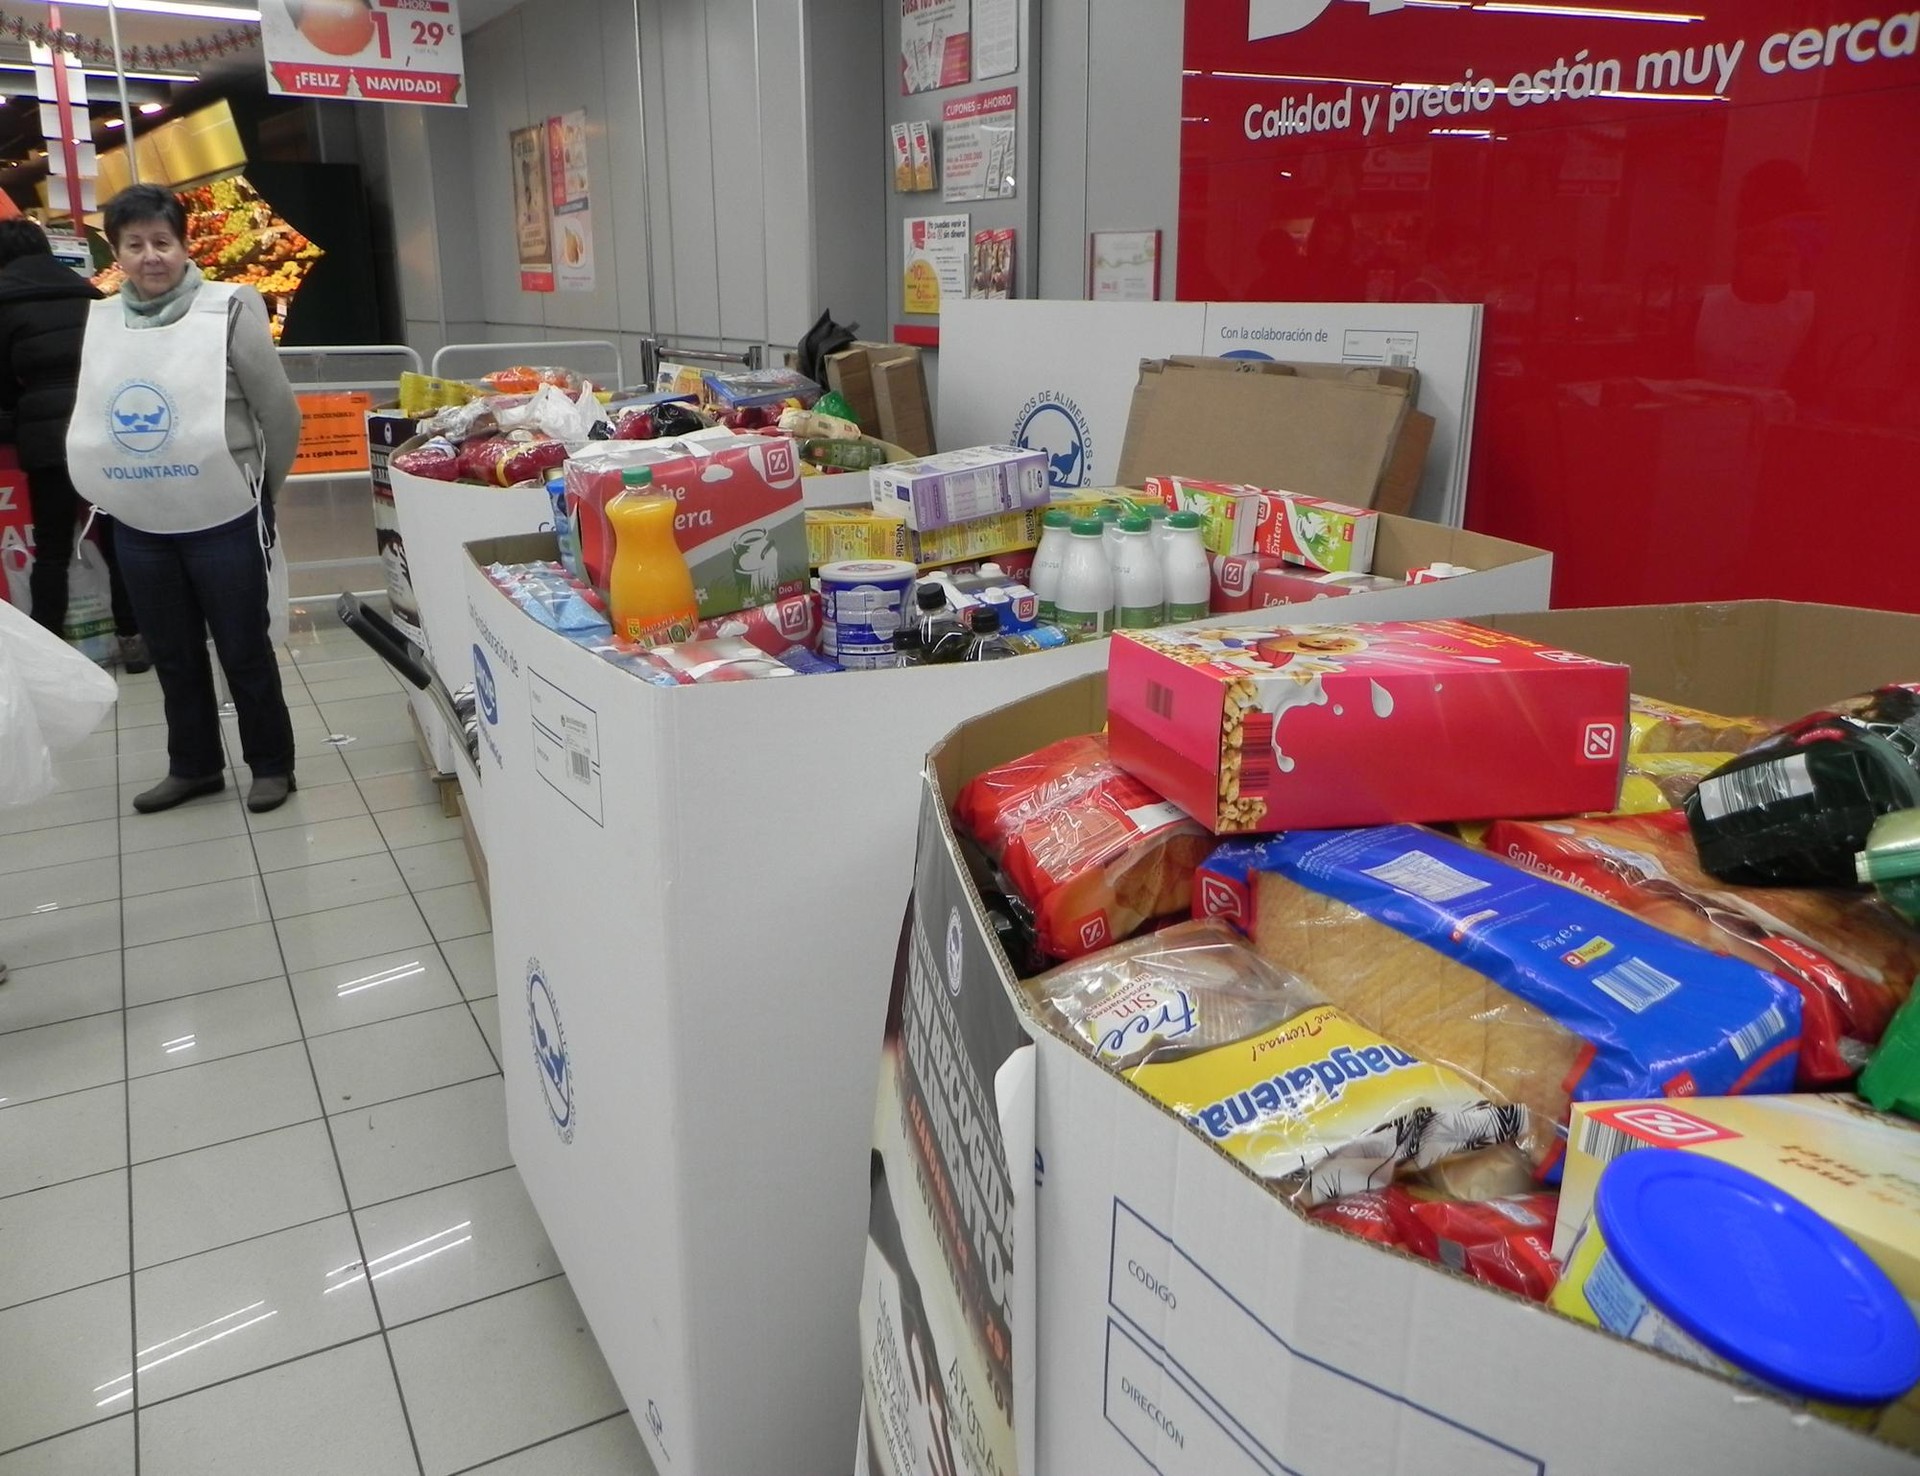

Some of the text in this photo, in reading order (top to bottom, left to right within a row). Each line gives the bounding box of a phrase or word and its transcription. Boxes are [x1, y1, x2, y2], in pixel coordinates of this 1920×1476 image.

[295, 72, 442, 94] ¡FELIZ NAVIDAD!
[1244, 11, 1920, 140] Calidad y precio están muy cerca
[946, 101, 976, 117] CUPONES
[983, 94, 1012, 110] AHORRO
[1220, 326, 1329, 342] Con la colaboración de
[1038, 390, 1052, 404] DE
[1054, 391, 1094, 460] ALIMENTOS
[102, 463, 200, 480] VOLUNTARIO
[895, 522, 905, 557] Nestlé
[1270, 511, 1284, 556] Entera
[1263, 592, 1293, 608] Lech
[1507, 842, 1566, 880] Galleta
[1095, 989, 1198, 1058] Free
[1112, 992, 1158, 1020] Sin
[1251, 1021, 1323, 1062] Tiernas!
[1127, 1258, 1178, 1311] CODIGO
[1120, 1375, 1186, 1450] DIRECCIÓN
